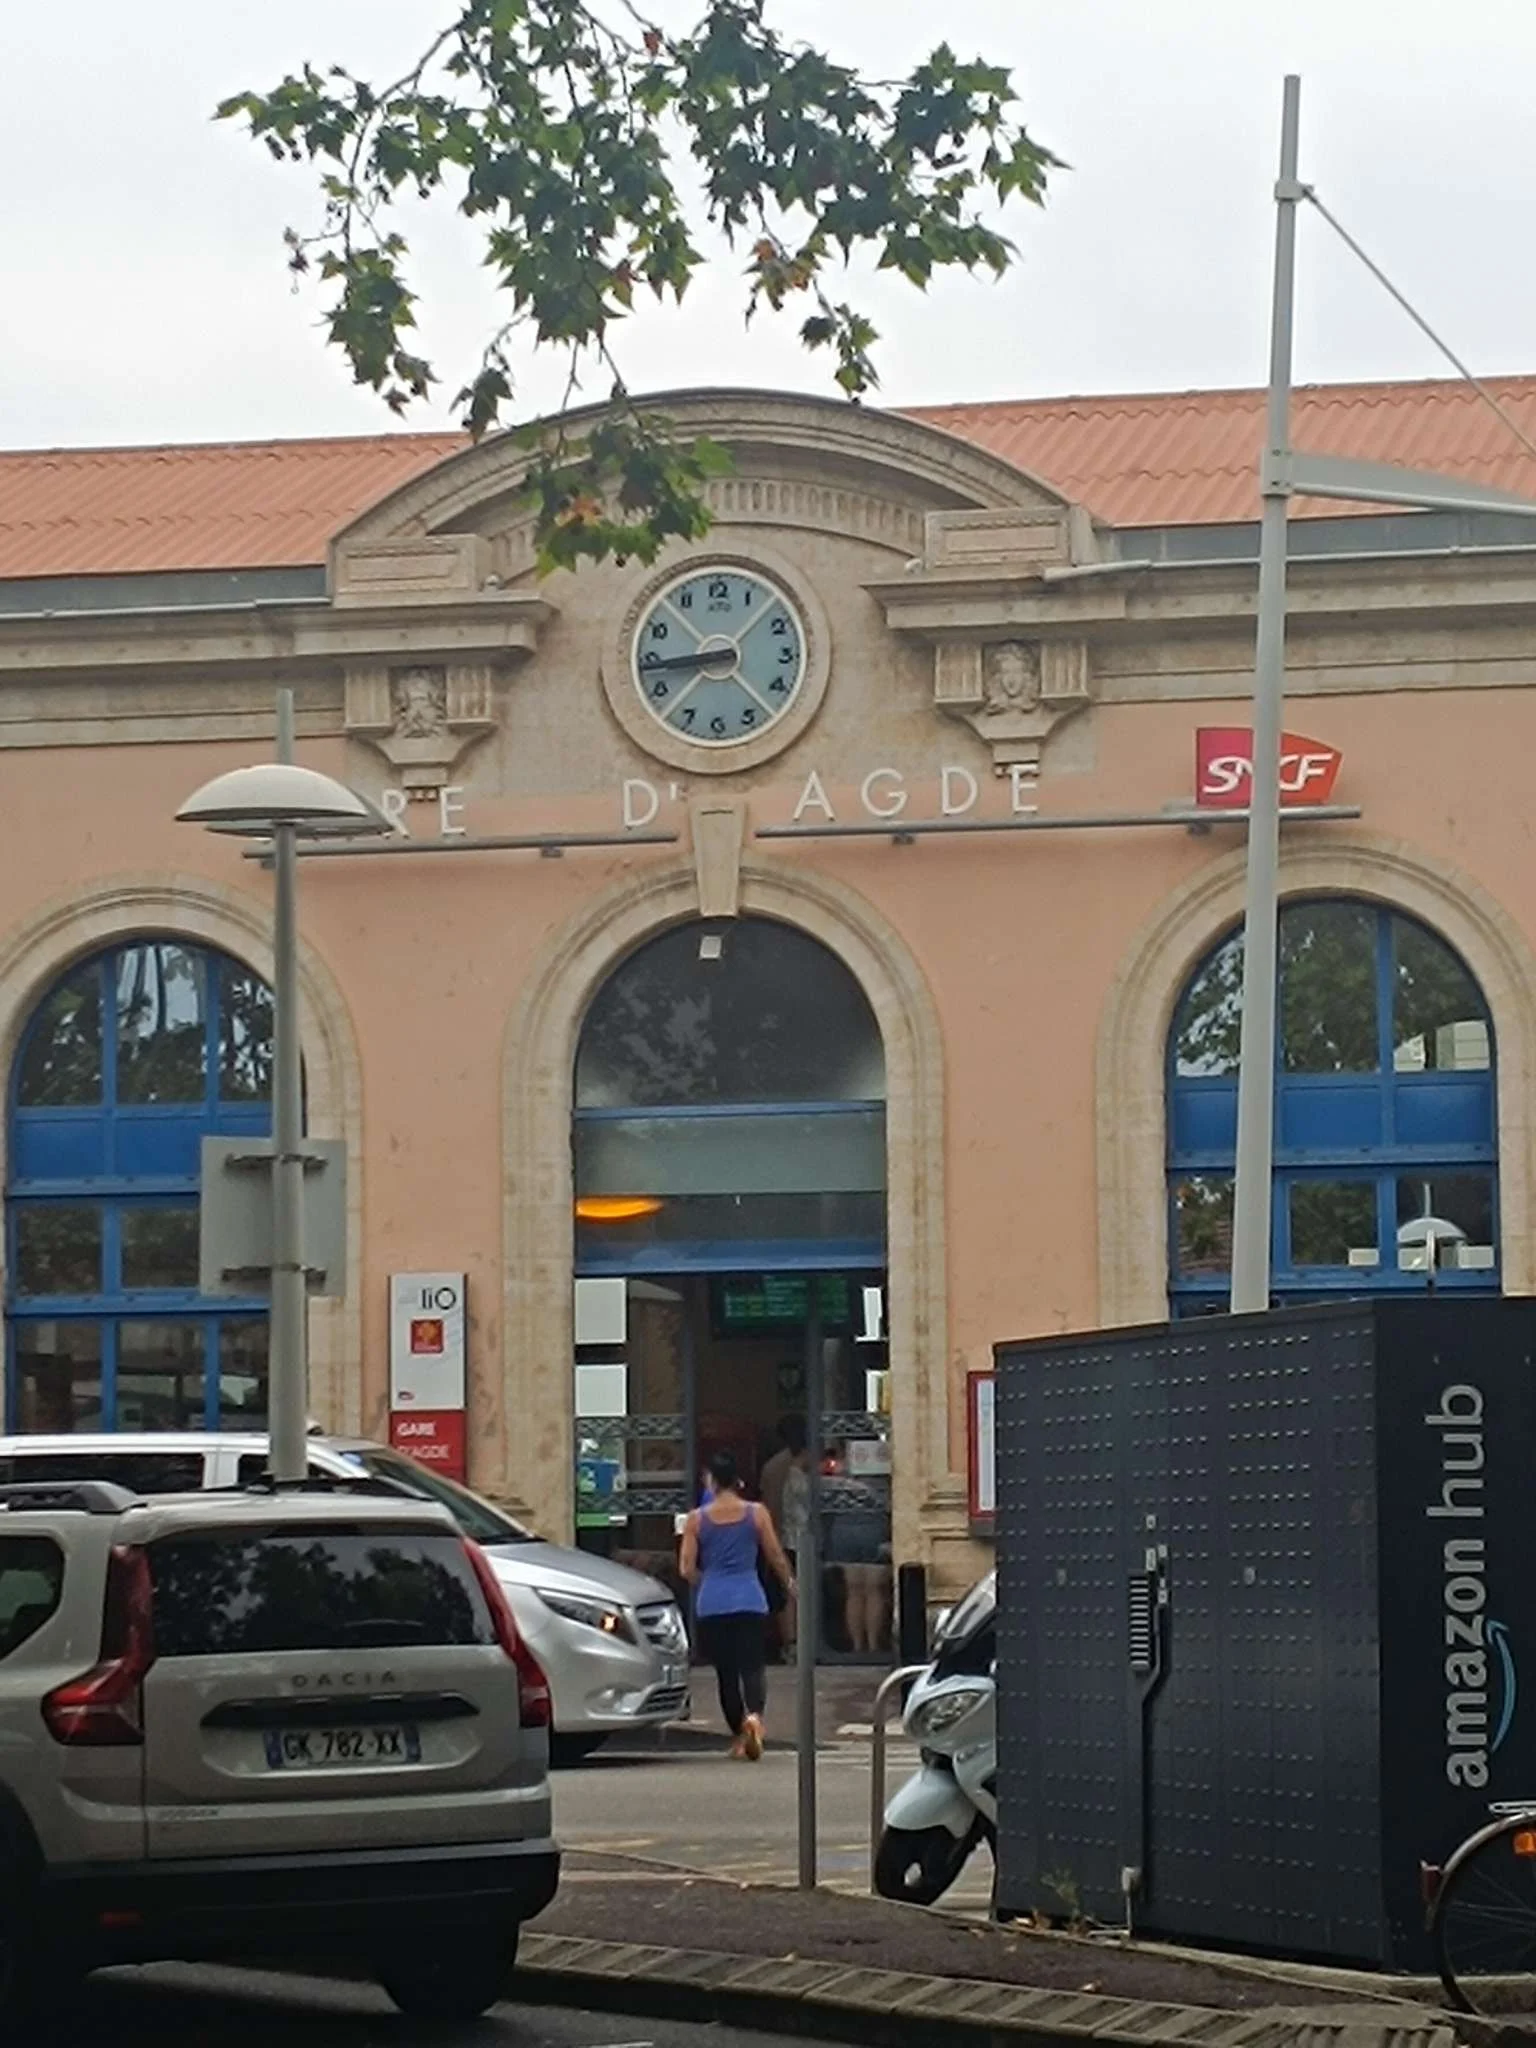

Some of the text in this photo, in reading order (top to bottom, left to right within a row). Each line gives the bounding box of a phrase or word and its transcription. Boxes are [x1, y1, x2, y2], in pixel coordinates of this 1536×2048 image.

[708, 581, 728, 598] 12
[680, 593, 692, 608] 11
[744, 591, 751, 606] 1
[652, 622, 668, 639] 10
[771, 618, 787, 635] 2
[777, 648, 793, 664] 3
[654, 681, 668, 697] 8
[768, 677, 785, 692] 4
[684, 709, 696, 724] 7
[741, 709, 756, 725] 5
[711, 717, 726, 734] 6
[623, 778, 680, 830] D'
[793, 763, 1039, 821] AGDE
[397, 1422, 436, 1436] GARE
[1425, 1384, 1489, 1789] amazon hub
[291, 1671, 396, 1688] DACIA
